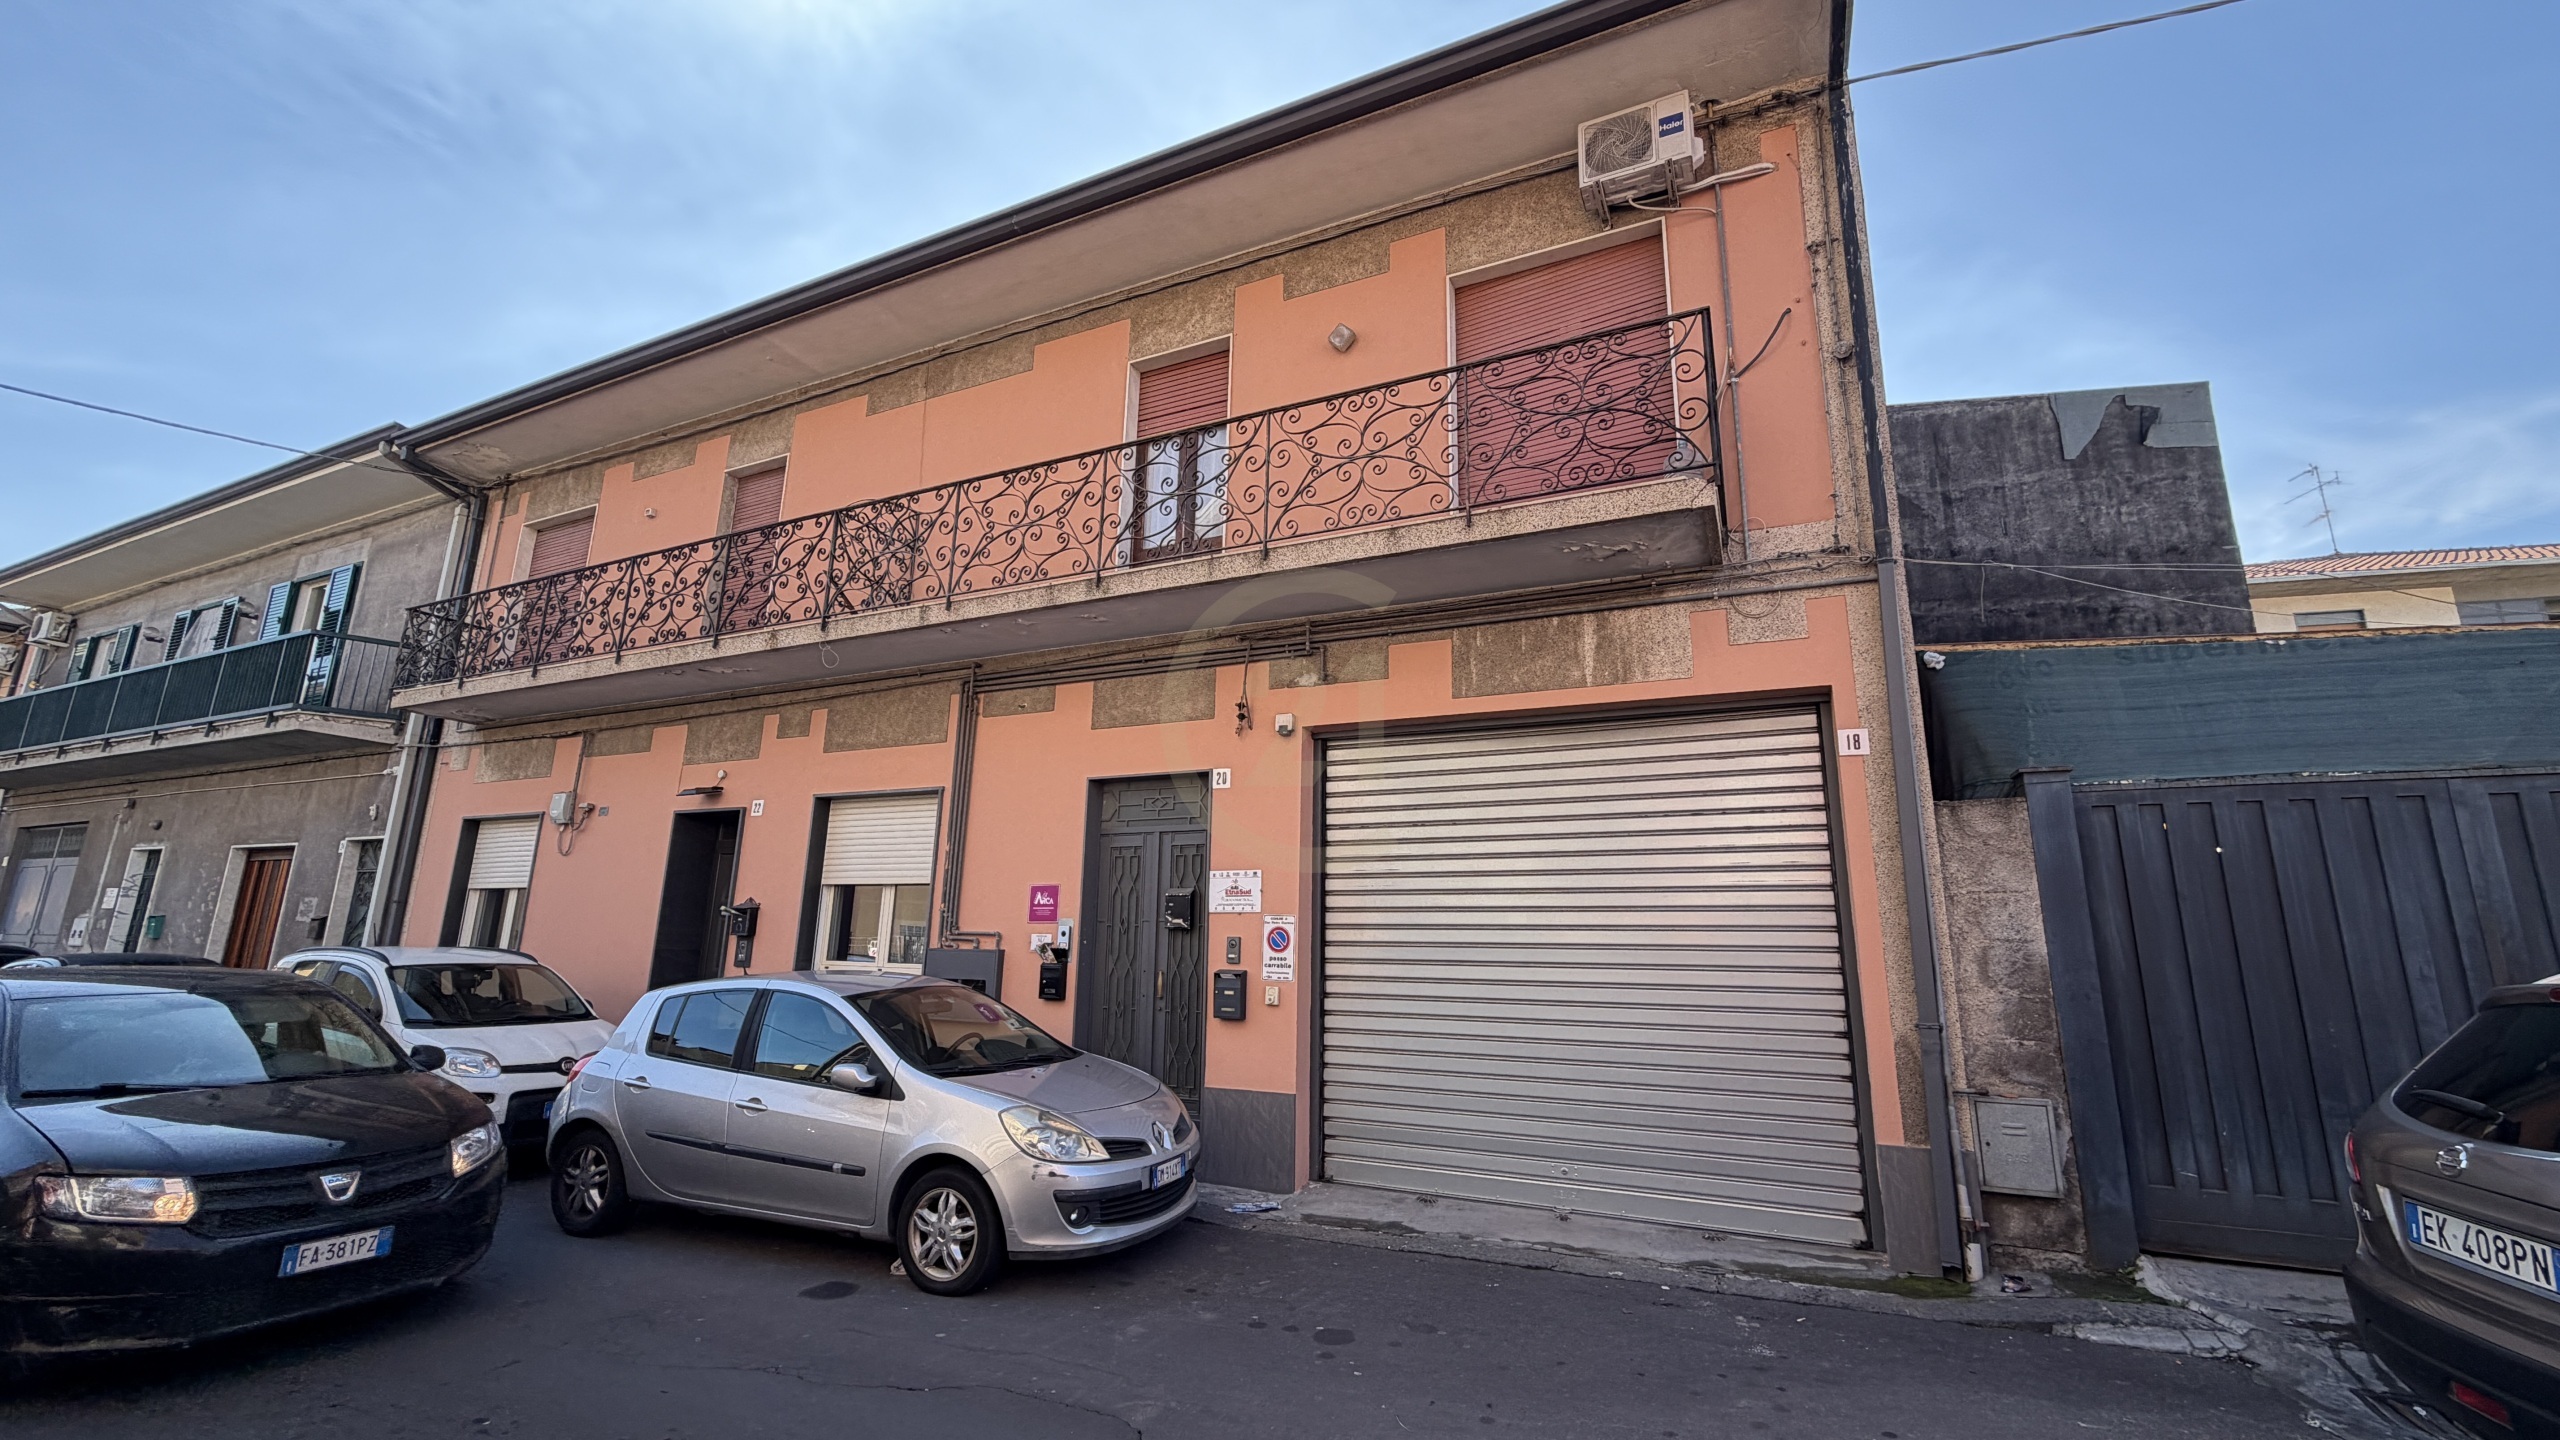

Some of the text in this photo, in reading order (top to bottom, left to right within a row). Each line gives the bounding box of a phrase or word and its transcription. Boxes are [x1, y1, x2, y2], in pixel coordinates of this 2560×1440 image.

[1846, 733, 1861, 751] 18
[1216, 771, 1227, 786] 20
[752, 802, 762, 814] 22
